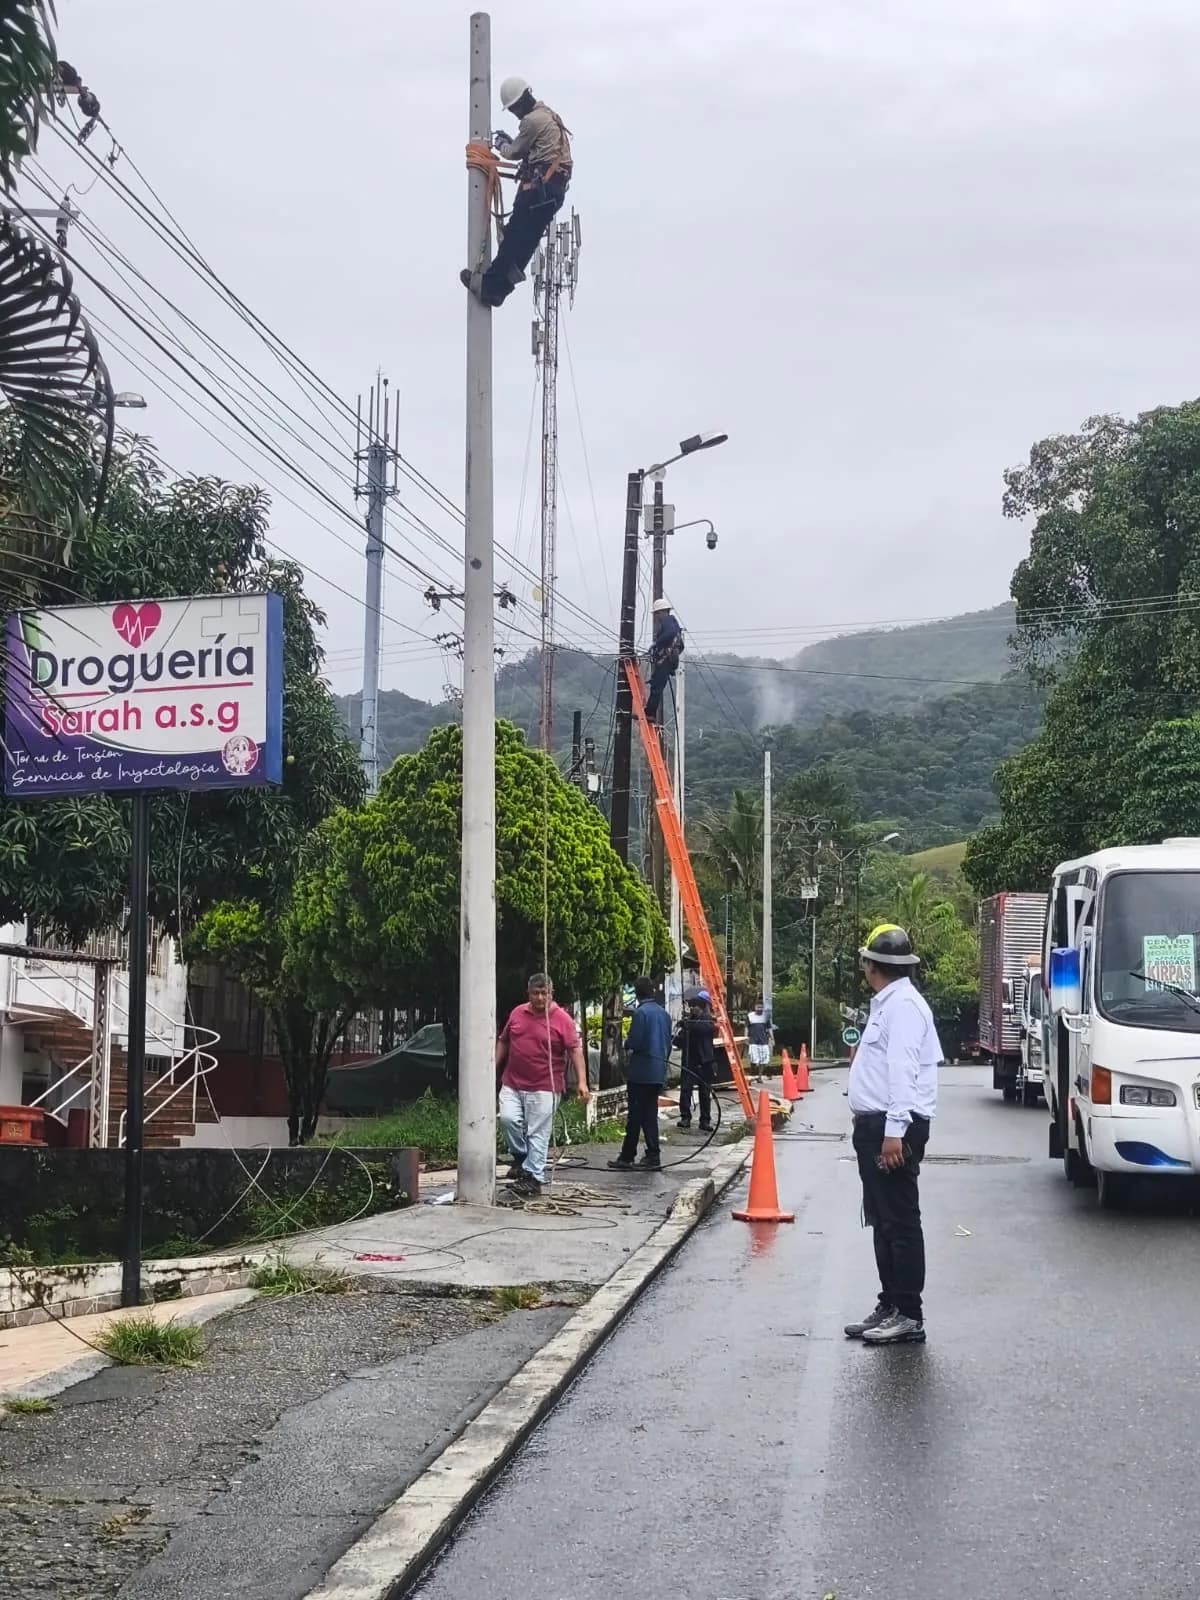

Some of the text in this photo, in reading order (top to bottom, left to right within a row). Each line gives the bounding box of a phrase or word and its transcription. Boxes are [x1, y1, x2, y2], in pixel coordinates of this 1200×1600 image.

[31, 633, 254, 693] Droguería
[42, 700, 239, 736] Sarah a.s.g
[52, 749, 69, 763] de
[11, 769, 86, 787] Servicio
[90, 767, 112, 780] de
[1147, 965, 1192, 981] KIRPAS
